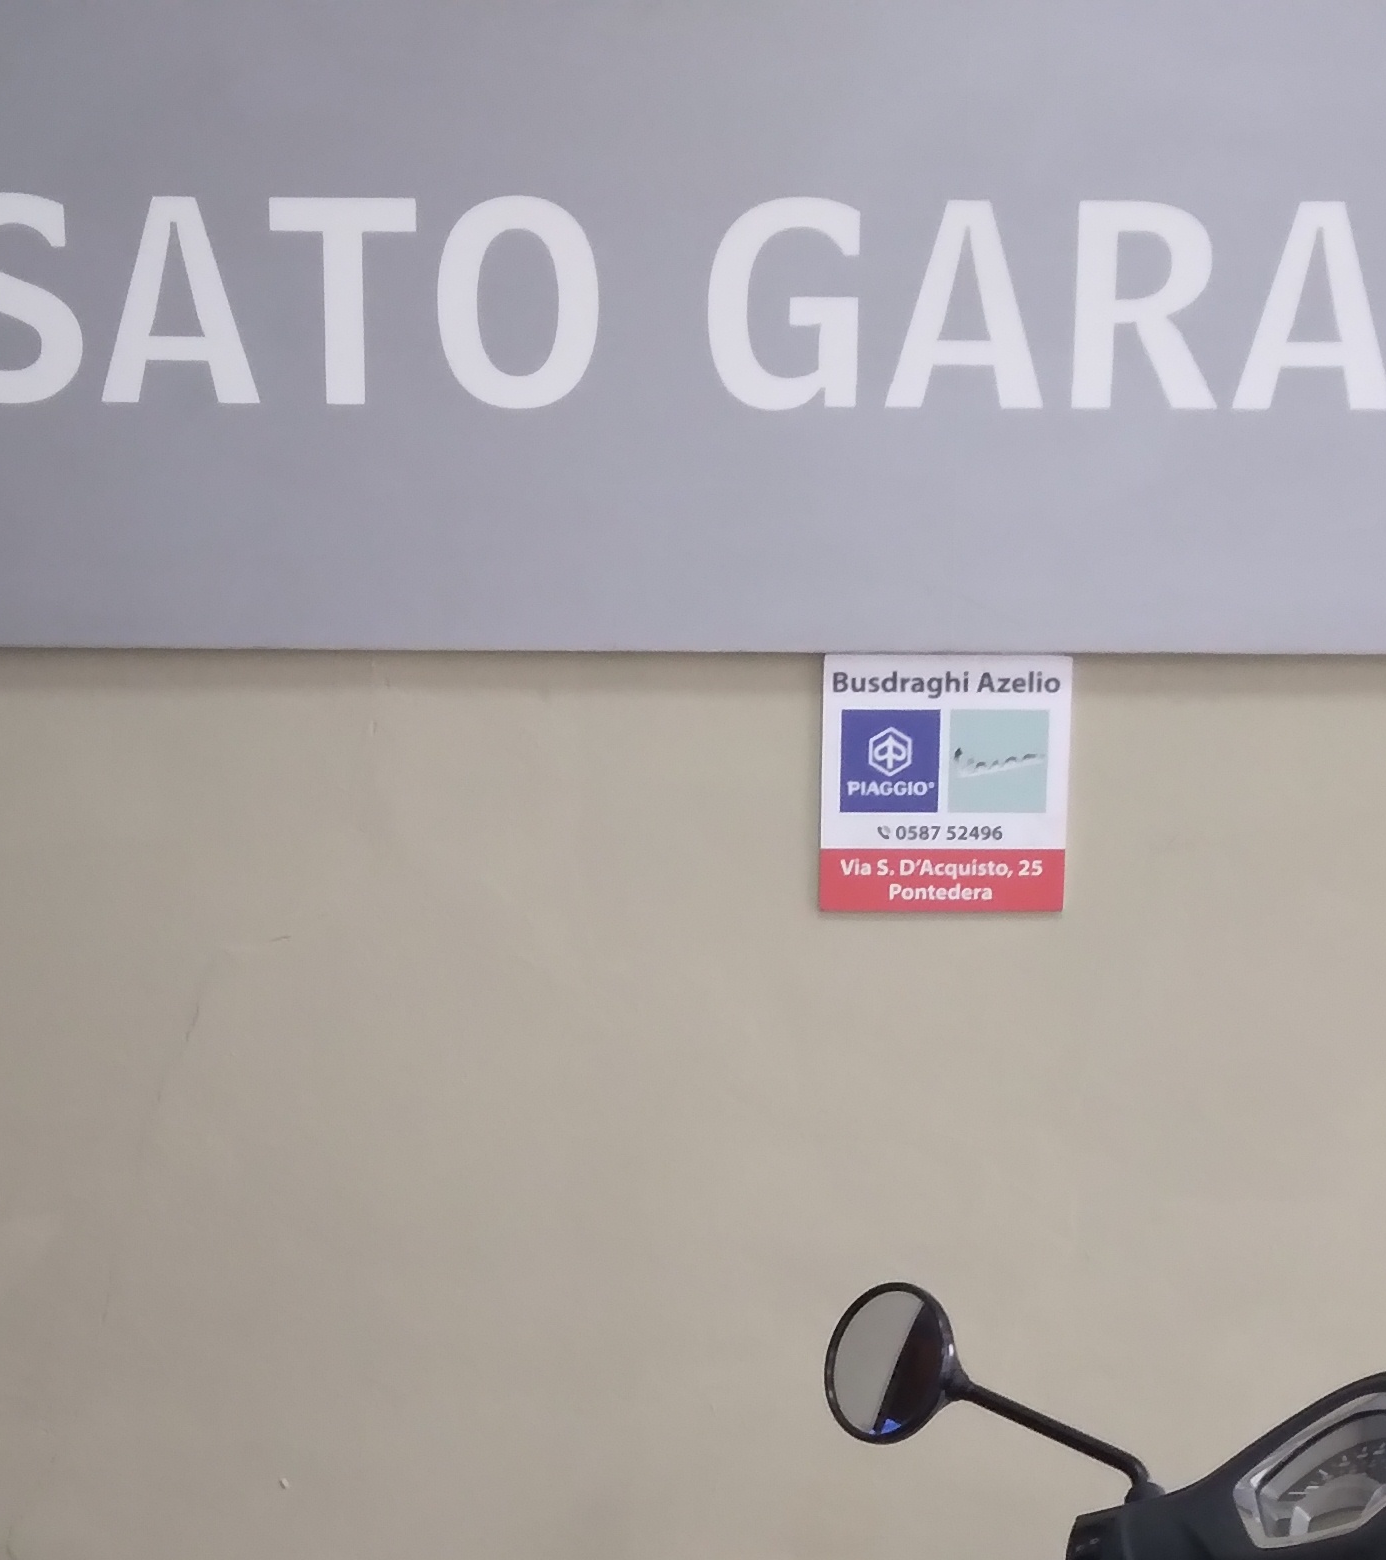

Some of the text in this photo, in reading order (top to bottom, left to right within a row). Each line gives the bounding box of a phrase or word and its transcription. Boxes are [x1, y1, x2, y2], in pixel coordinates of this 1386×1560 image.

[832, 671, 1061, 699] Busdraghi Azelio
[847, 780, 929, 796] PIAGGIO
[895, 825, 1003, 841] 0587 52496
[840, 858, 872, 876] Via
[876, 859, 895, 876] S.
[1018, 859, 1043, 876] 25
[888, 883, 993, 901] Pontedera
